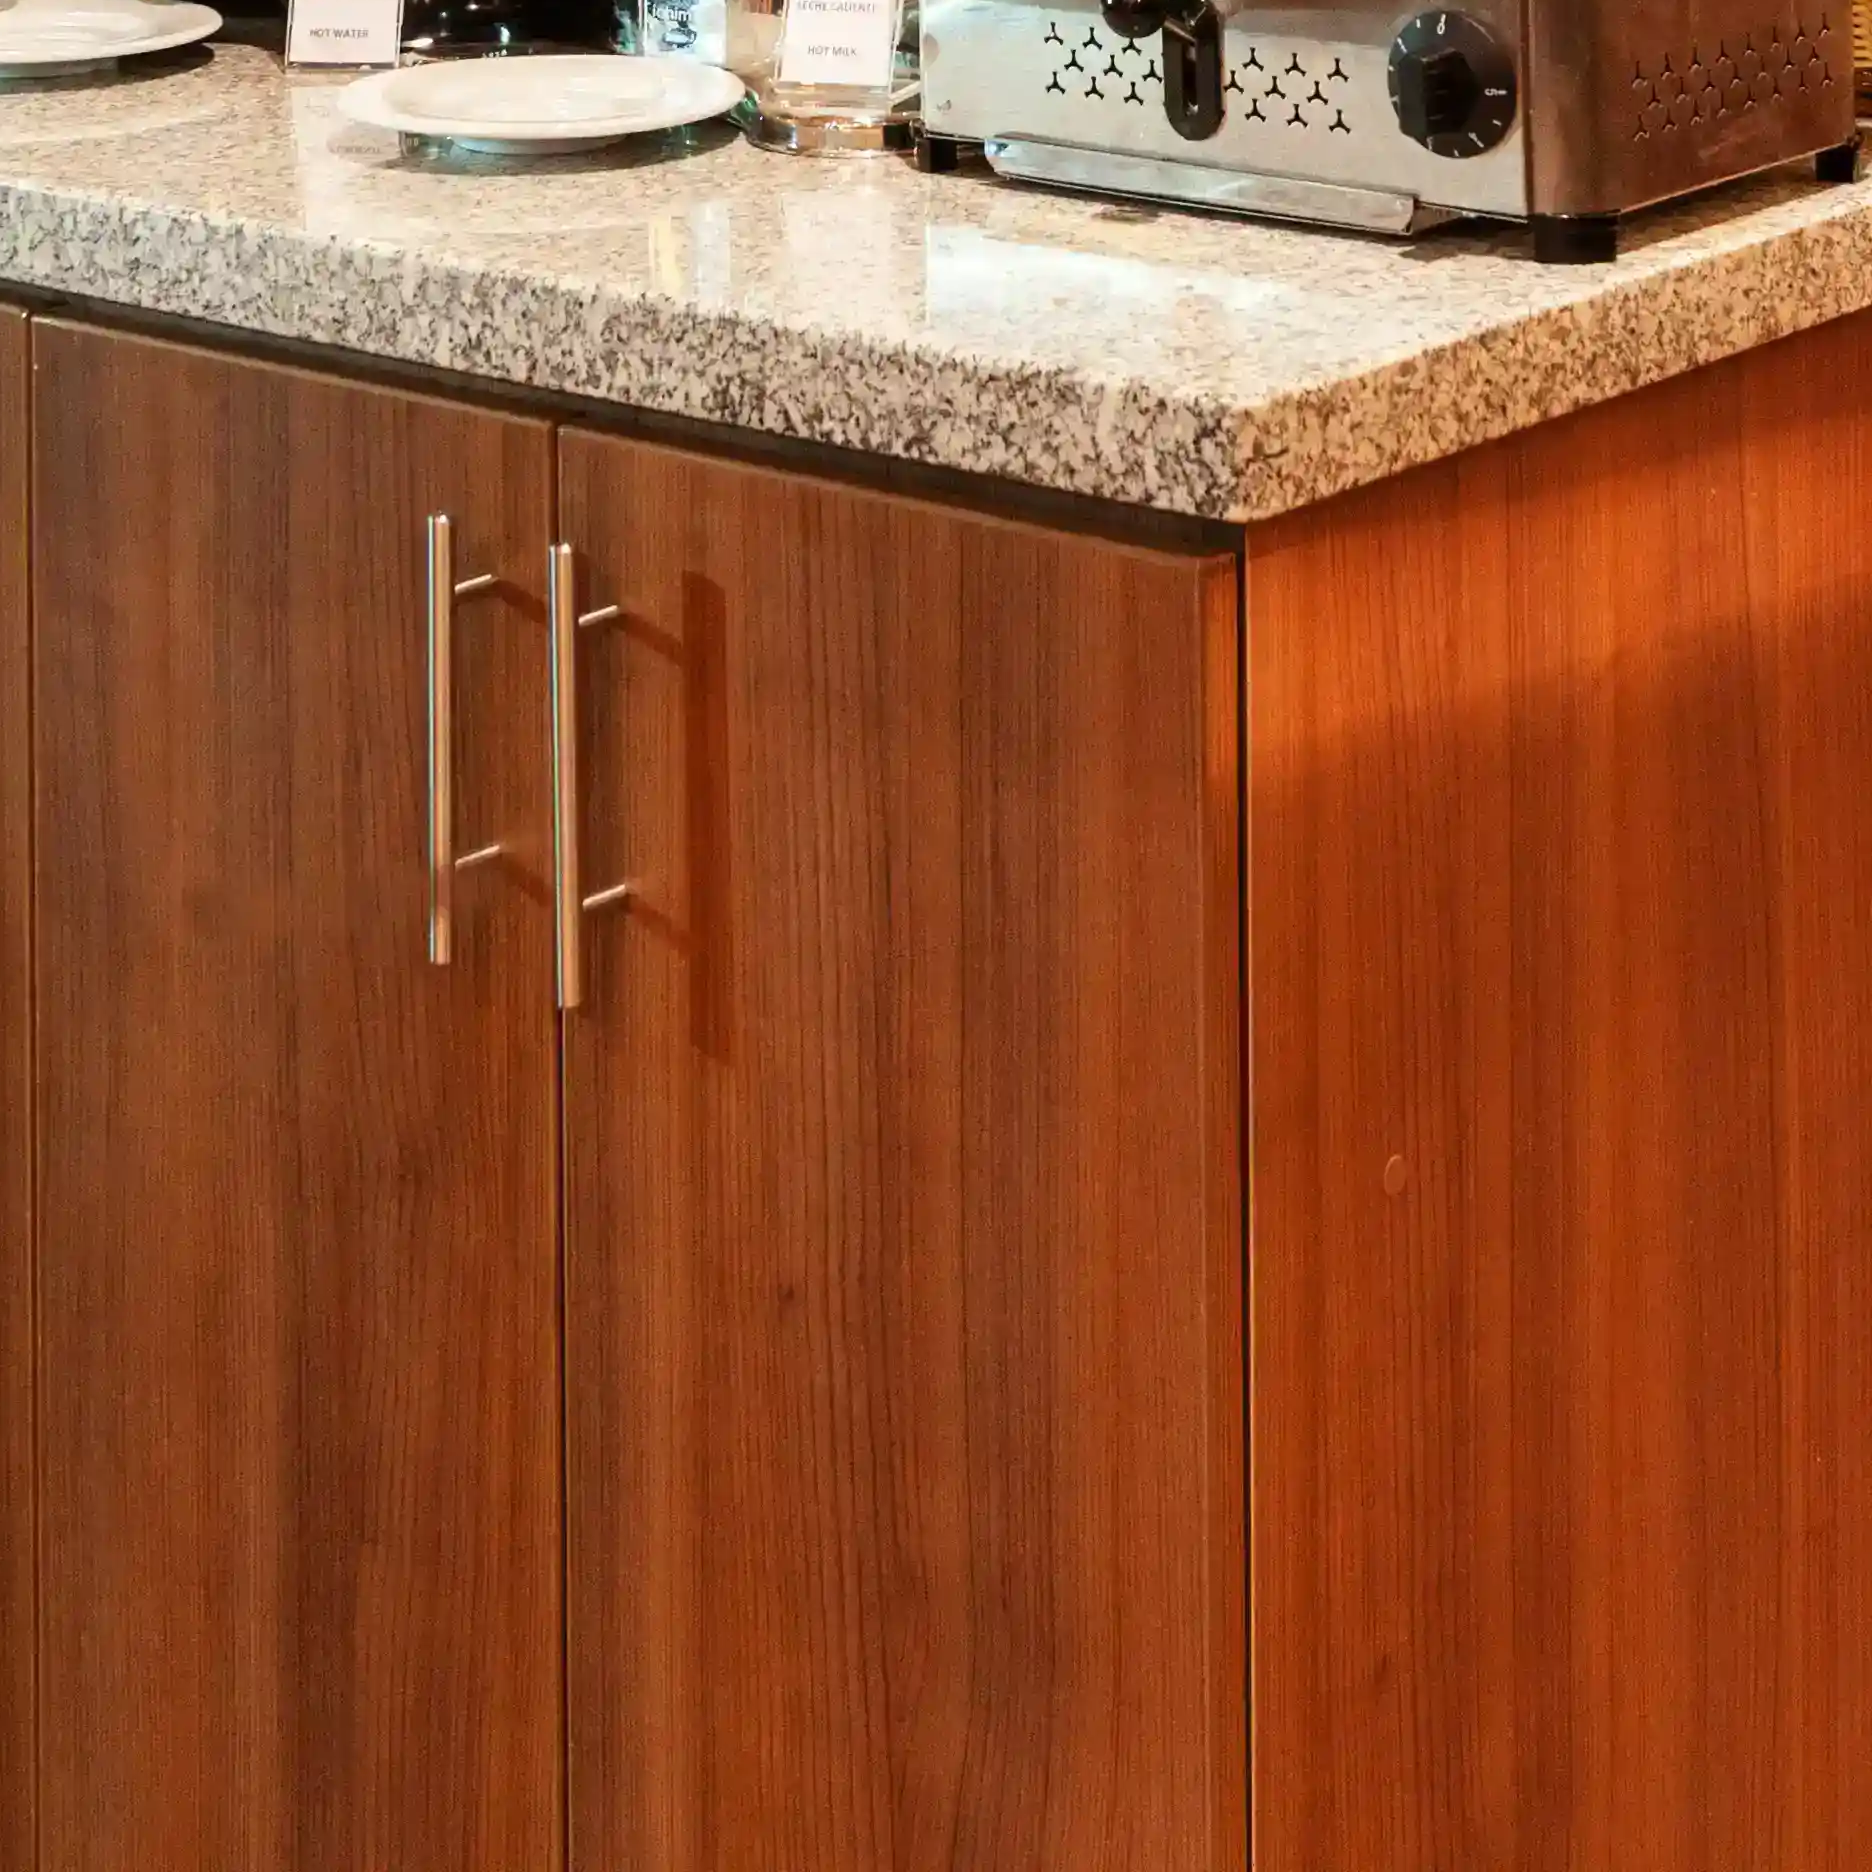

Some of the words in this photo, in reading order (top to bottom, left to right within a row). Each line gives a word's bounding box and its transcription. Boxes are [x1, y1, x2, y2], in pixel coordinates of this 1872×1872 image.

[309, 28, 331, 38] HOT
[807, 45, 829, 56] HOT
[831, 46, 858, 57] MILK
